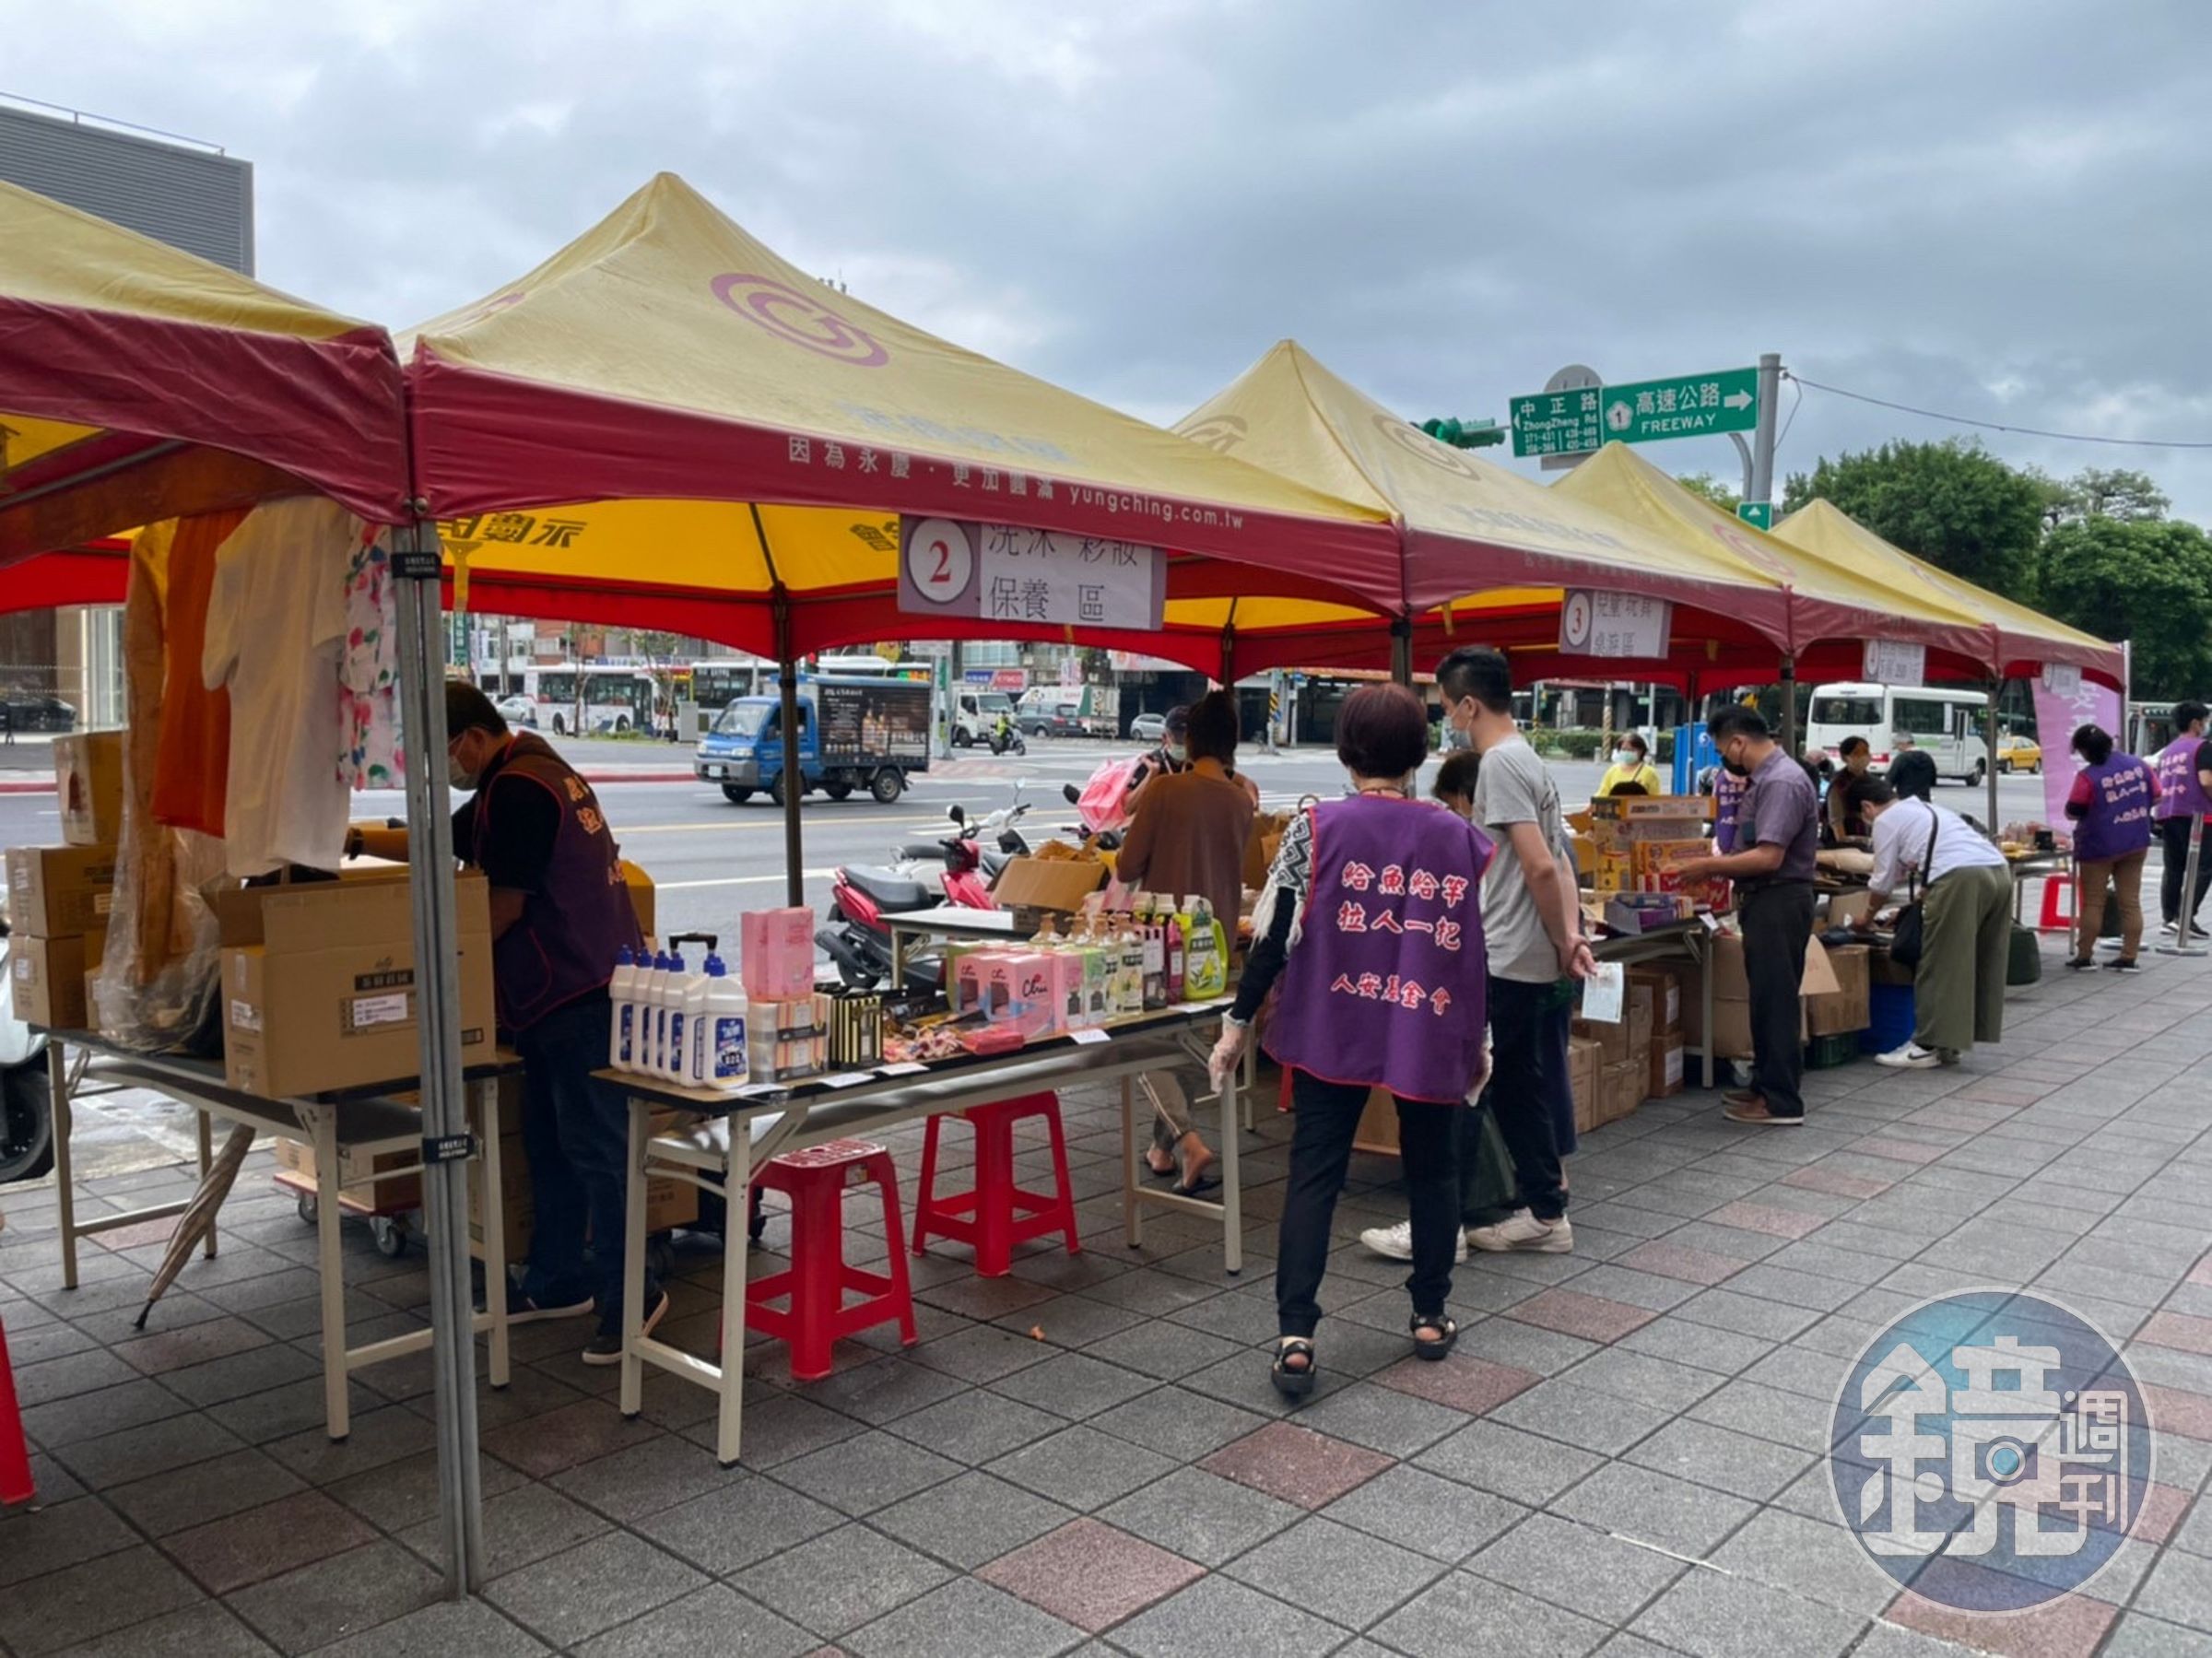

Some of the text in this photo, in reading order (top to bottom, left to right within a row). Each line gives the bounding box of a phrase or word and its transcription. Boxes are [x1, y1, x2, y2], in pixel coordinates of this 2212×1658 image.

[1521, 392, 1598, 418] 中正路
[1636, 382, 1720, 417] 高速公路
[1641, 413, 1716, 435] FREEWAY
[1069, 485, 1244, 530] yungching.com.tw
[929, 540, 952, 582] 2
[1571, 607, 1583, 634] 3
[1342, 861, 1468, 908] 給魚給竿
[1338, 900, 1462, 951] 拉人一把
